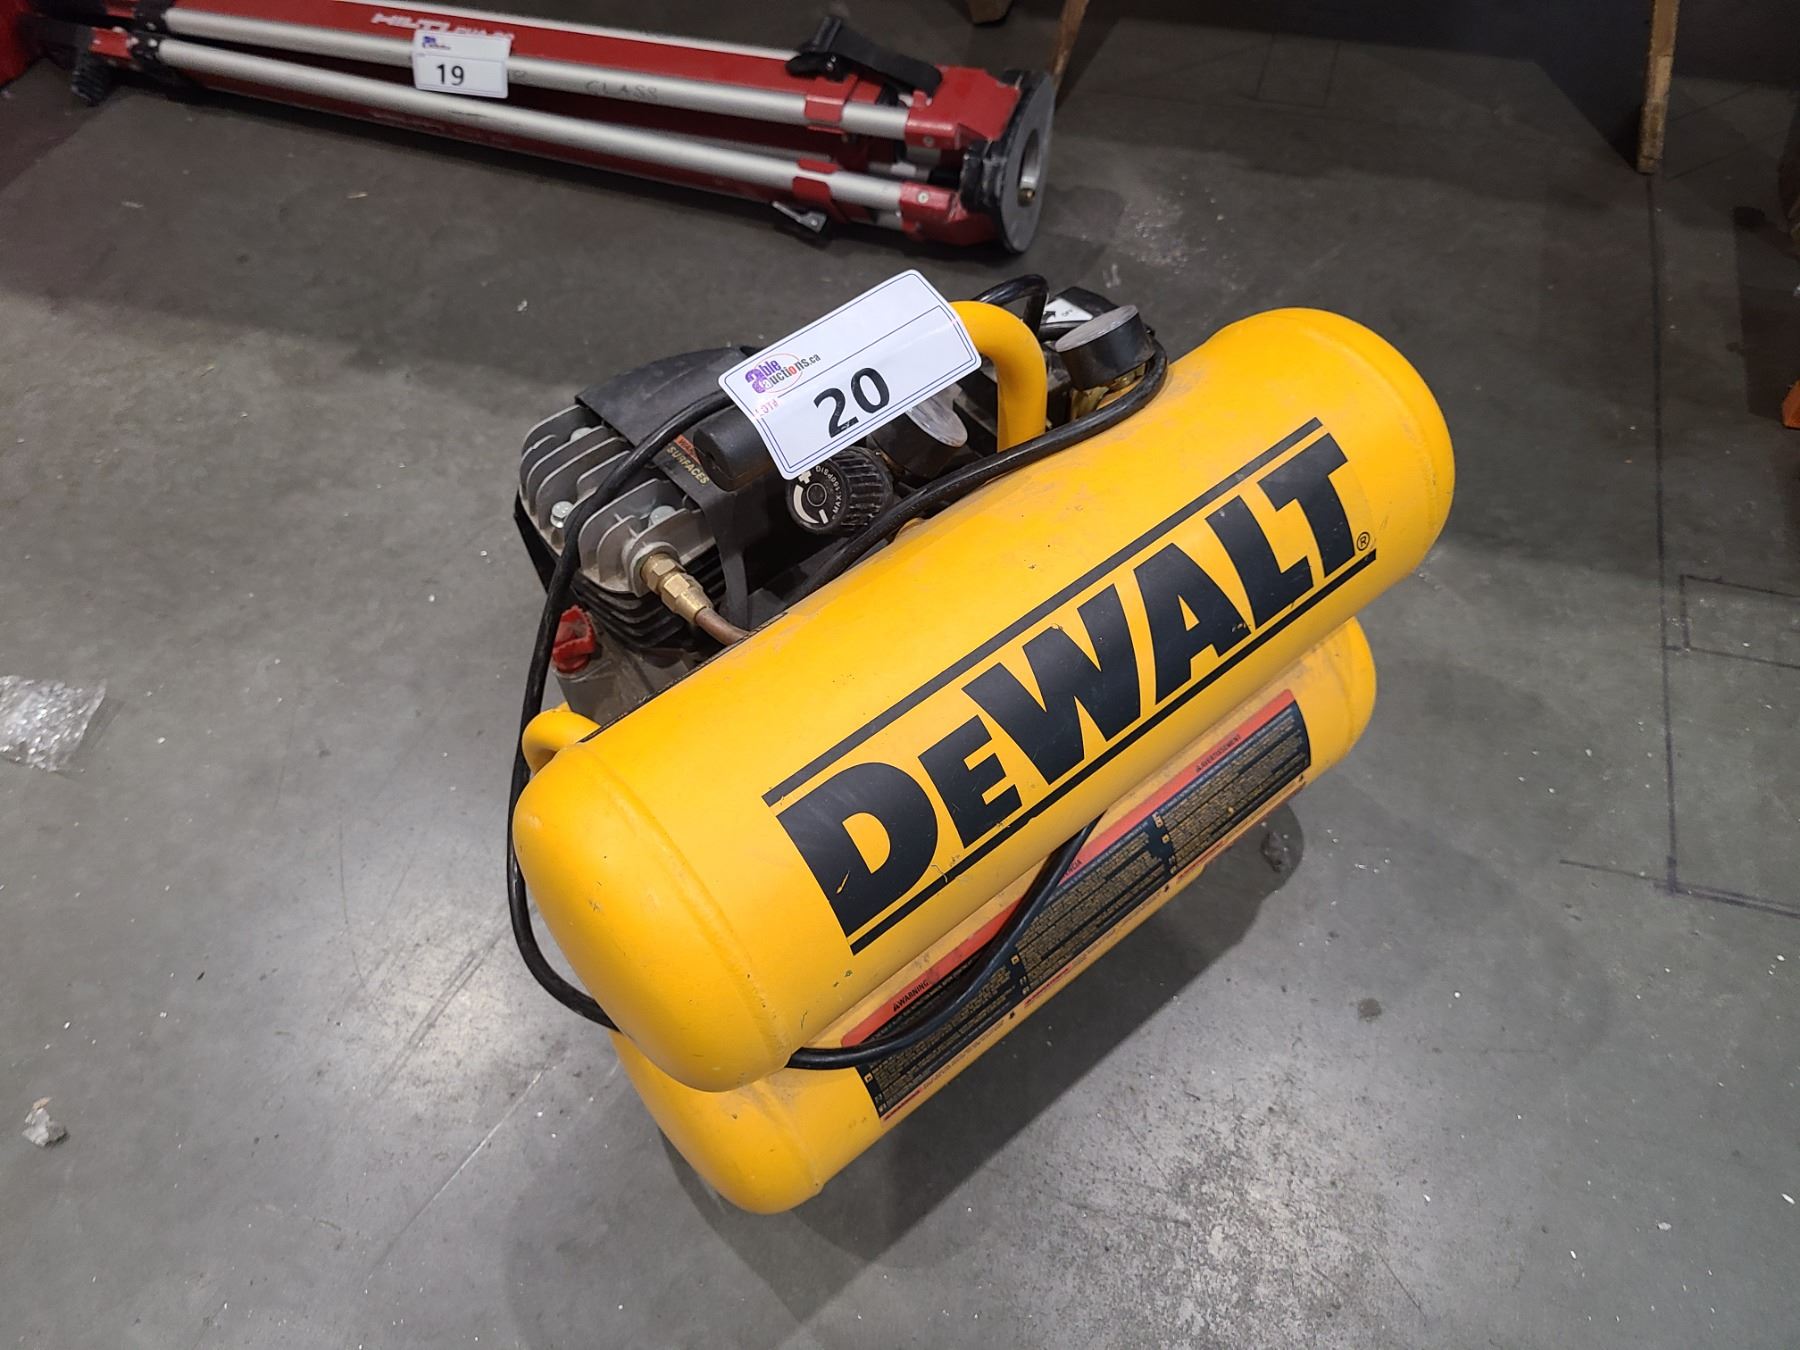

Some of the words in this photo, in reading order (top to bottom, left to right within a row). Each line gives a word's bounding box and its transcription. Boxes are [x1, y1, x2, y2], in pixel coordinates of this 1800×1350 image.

[437, 64, 464, 86] 19
[813, 367, 890, 439] 20
[667, 446, 710, 484] SURFACES
[776, 433, 1356, 938] DEWALT
[898, 980, 930, 1007] WARNING
